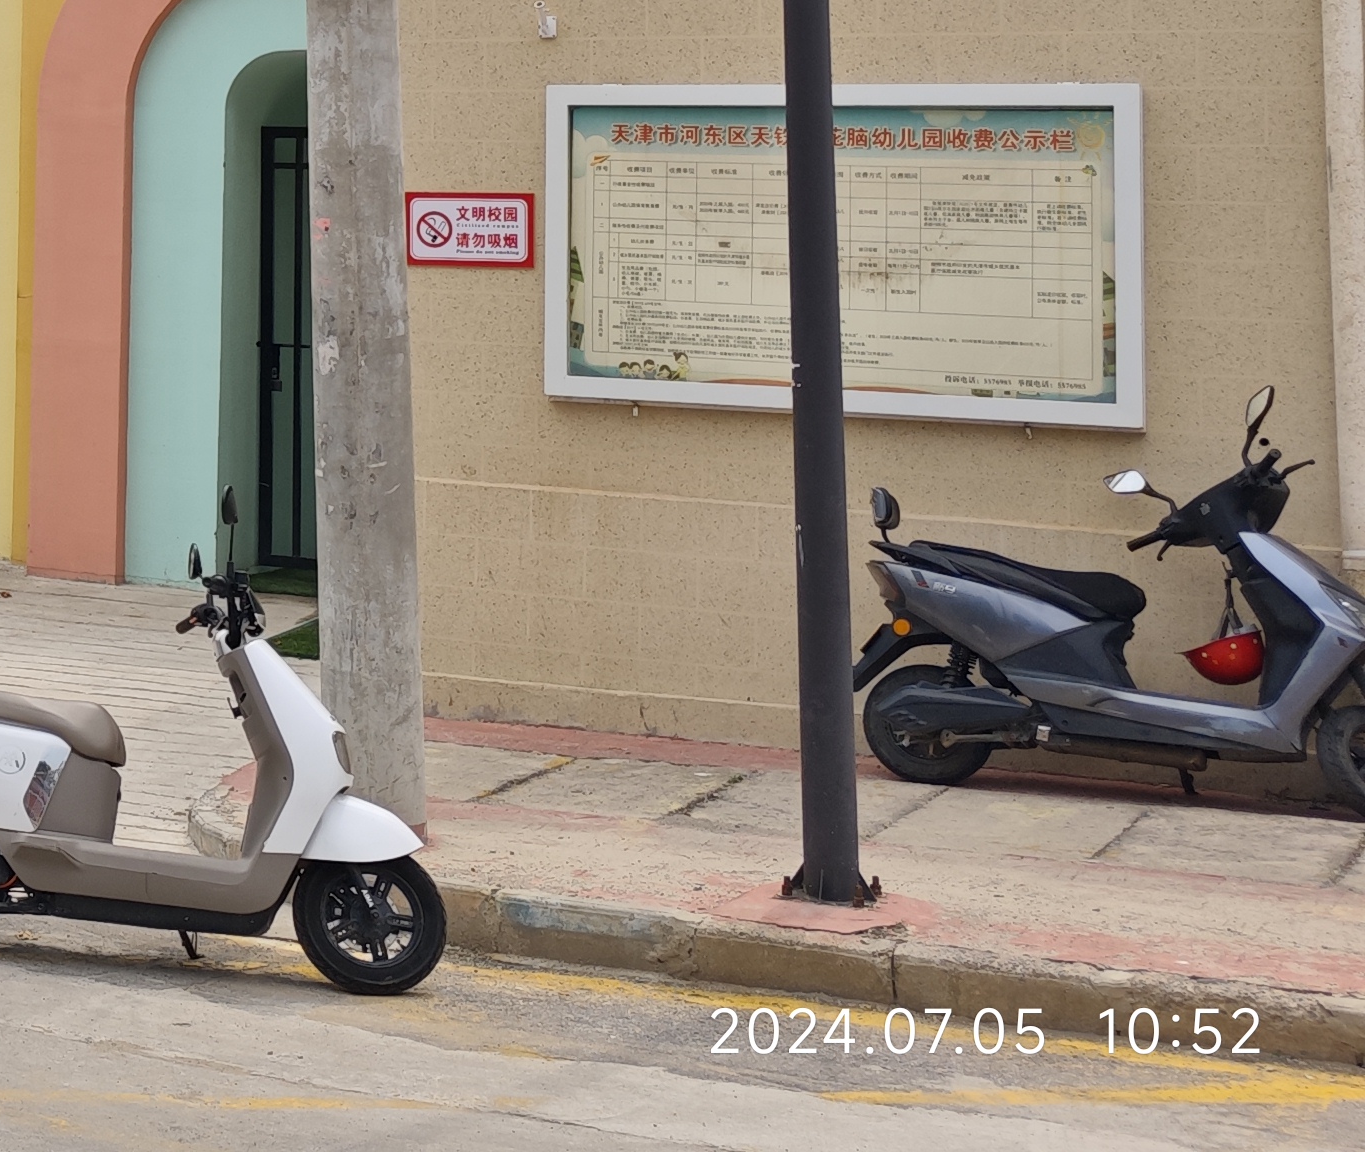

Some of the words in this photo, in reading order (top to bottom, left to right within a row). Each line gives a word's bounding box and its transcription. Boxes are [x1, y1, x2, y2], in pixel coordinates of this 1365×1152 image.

[611, 123, 1076, 151] 天津市河东区天铁花脑幼儿园收费公示栏
[456, 206, 518, 222] 文明校园
[456, 232, 518, 249] 请勿吸烟
